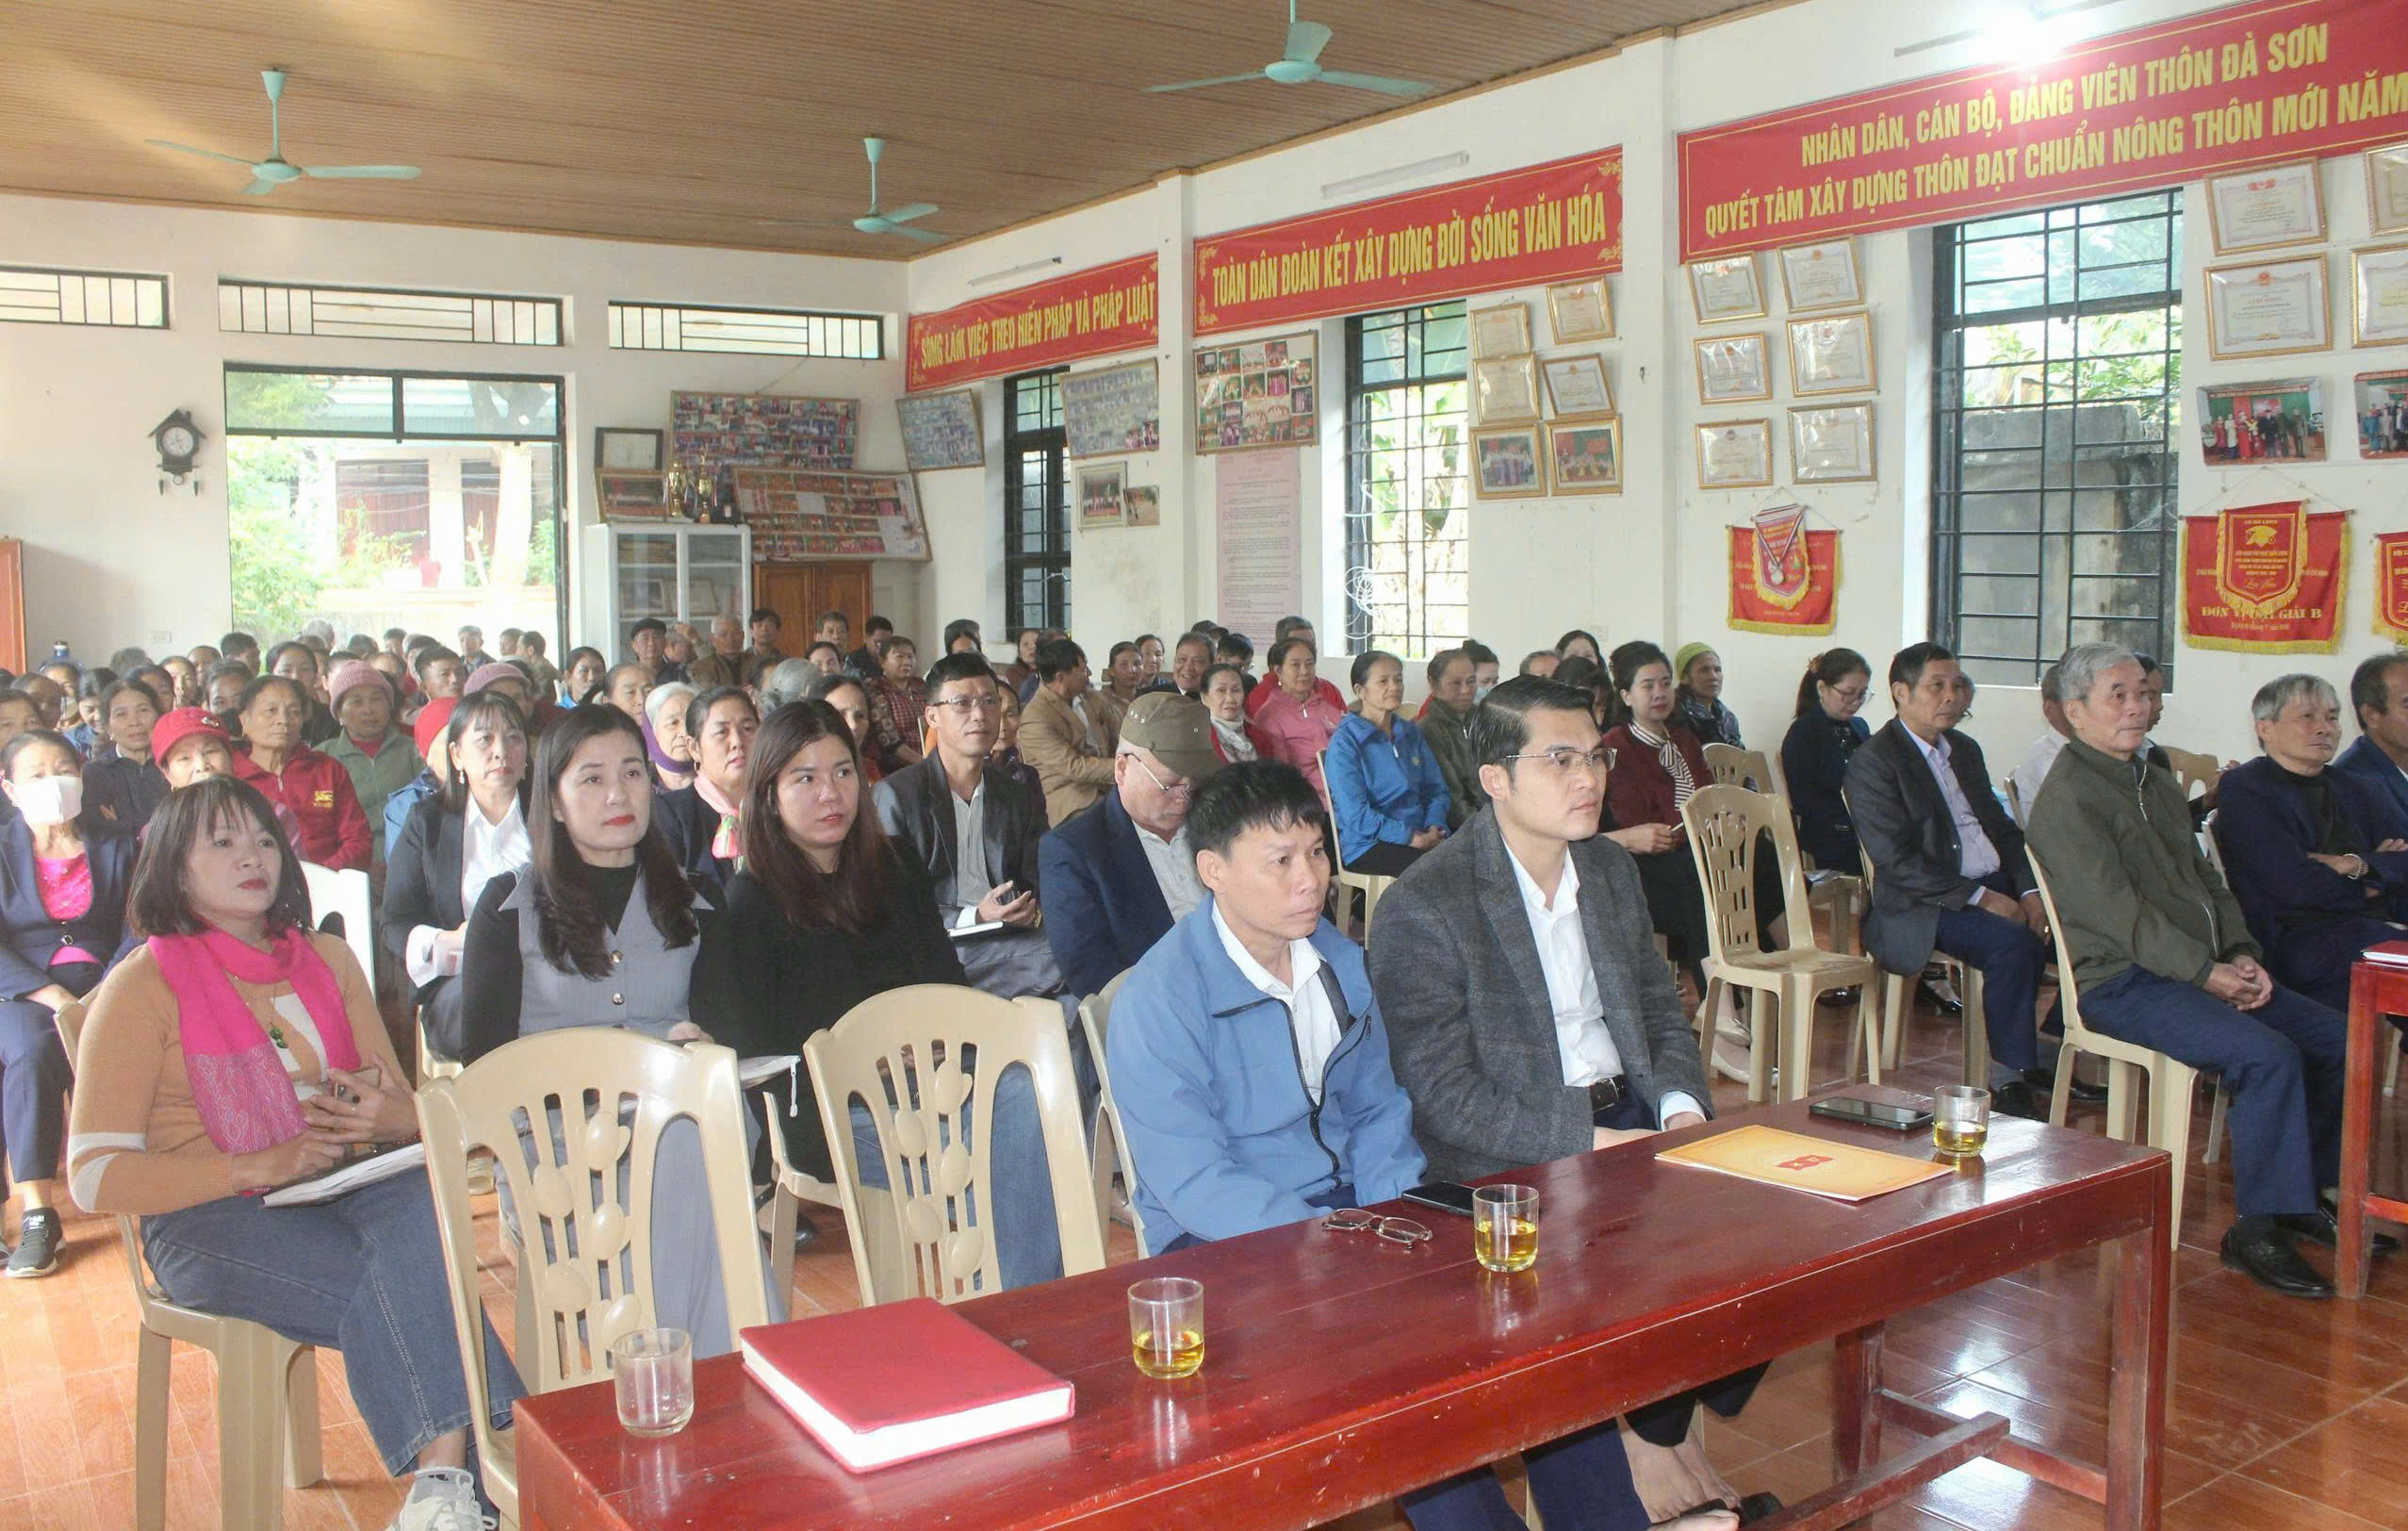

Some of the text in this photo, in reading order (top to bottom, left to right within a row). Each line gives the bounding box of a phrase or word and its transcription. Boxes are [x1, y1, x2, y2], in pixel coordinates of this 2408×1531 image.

[1705, 69, 2408, 239] QUYẾT TÂM XÂY DỰNG THÔN ĐẠT CHUẨN NÔNG THÔN MỚI NĂM
[1802, 23, 2328, 167] NHÂN DÂN, CÁN BỘ, ĐẢNG VIÊN THÔN ĐÀ SƠN
[1213, 183, 1606, 308] TOÀN DÂN ĐOÀN KẾT XÂY DỰNG ĐỜI SỐNG VĂN HÓA
[922, 275, 1155, 370] SỐNG LÀM VIỆC THEO HIẾN PHÁP VÀ PHÁP LUẬT
